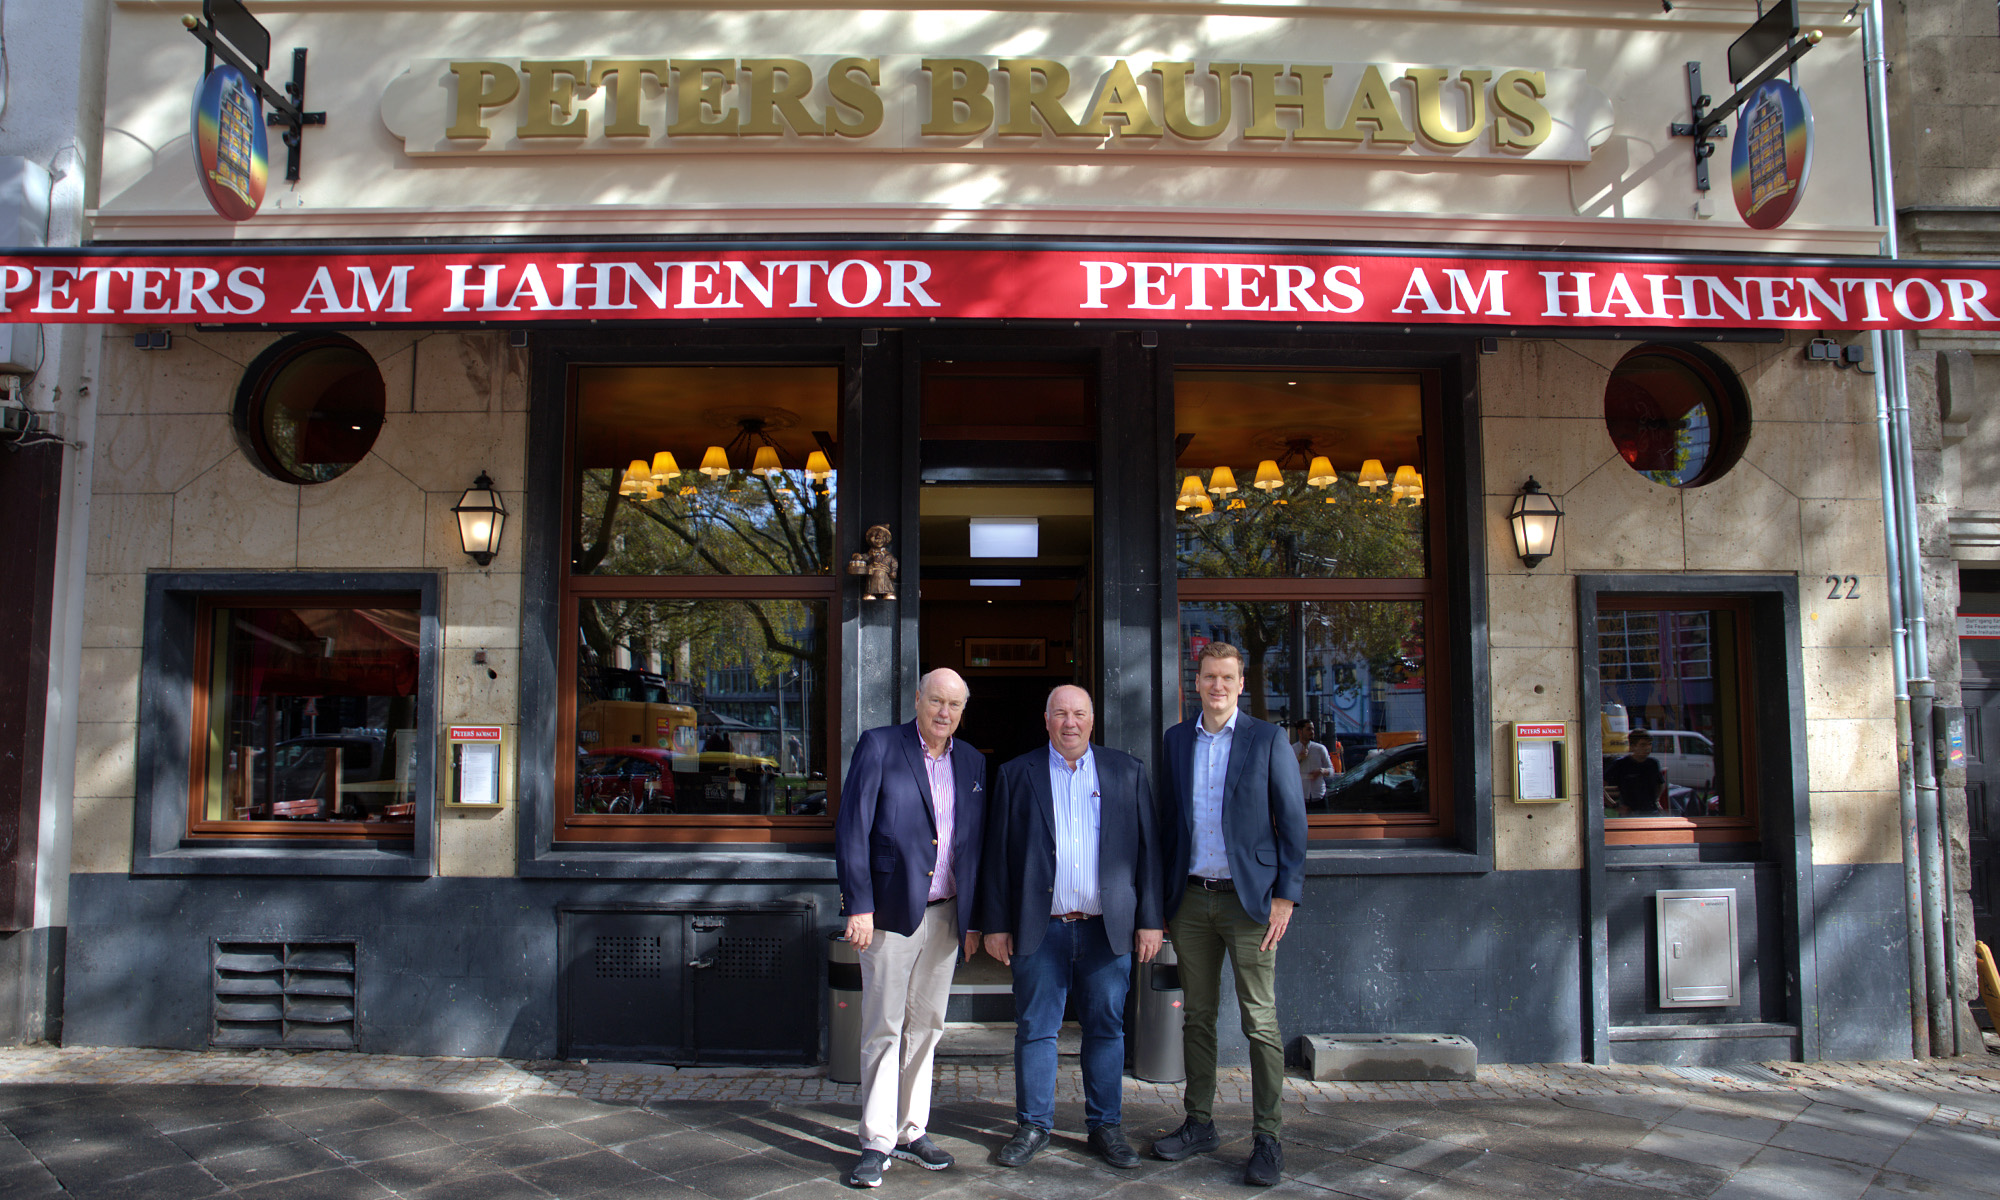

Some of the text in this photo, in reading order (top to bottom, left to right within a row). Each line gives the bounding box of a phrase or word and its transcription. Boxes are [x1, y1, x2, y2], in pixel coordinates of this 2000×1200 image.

[446, 57, 1553, 149] PETERS BRAUHAUS
[0, 259, 942, 314] PETERS AM HAHNENTOR
[1080, 260, 2000, 323] PETERS AM HAHNENTOR
[1825, 574, 1861, 600] 22
